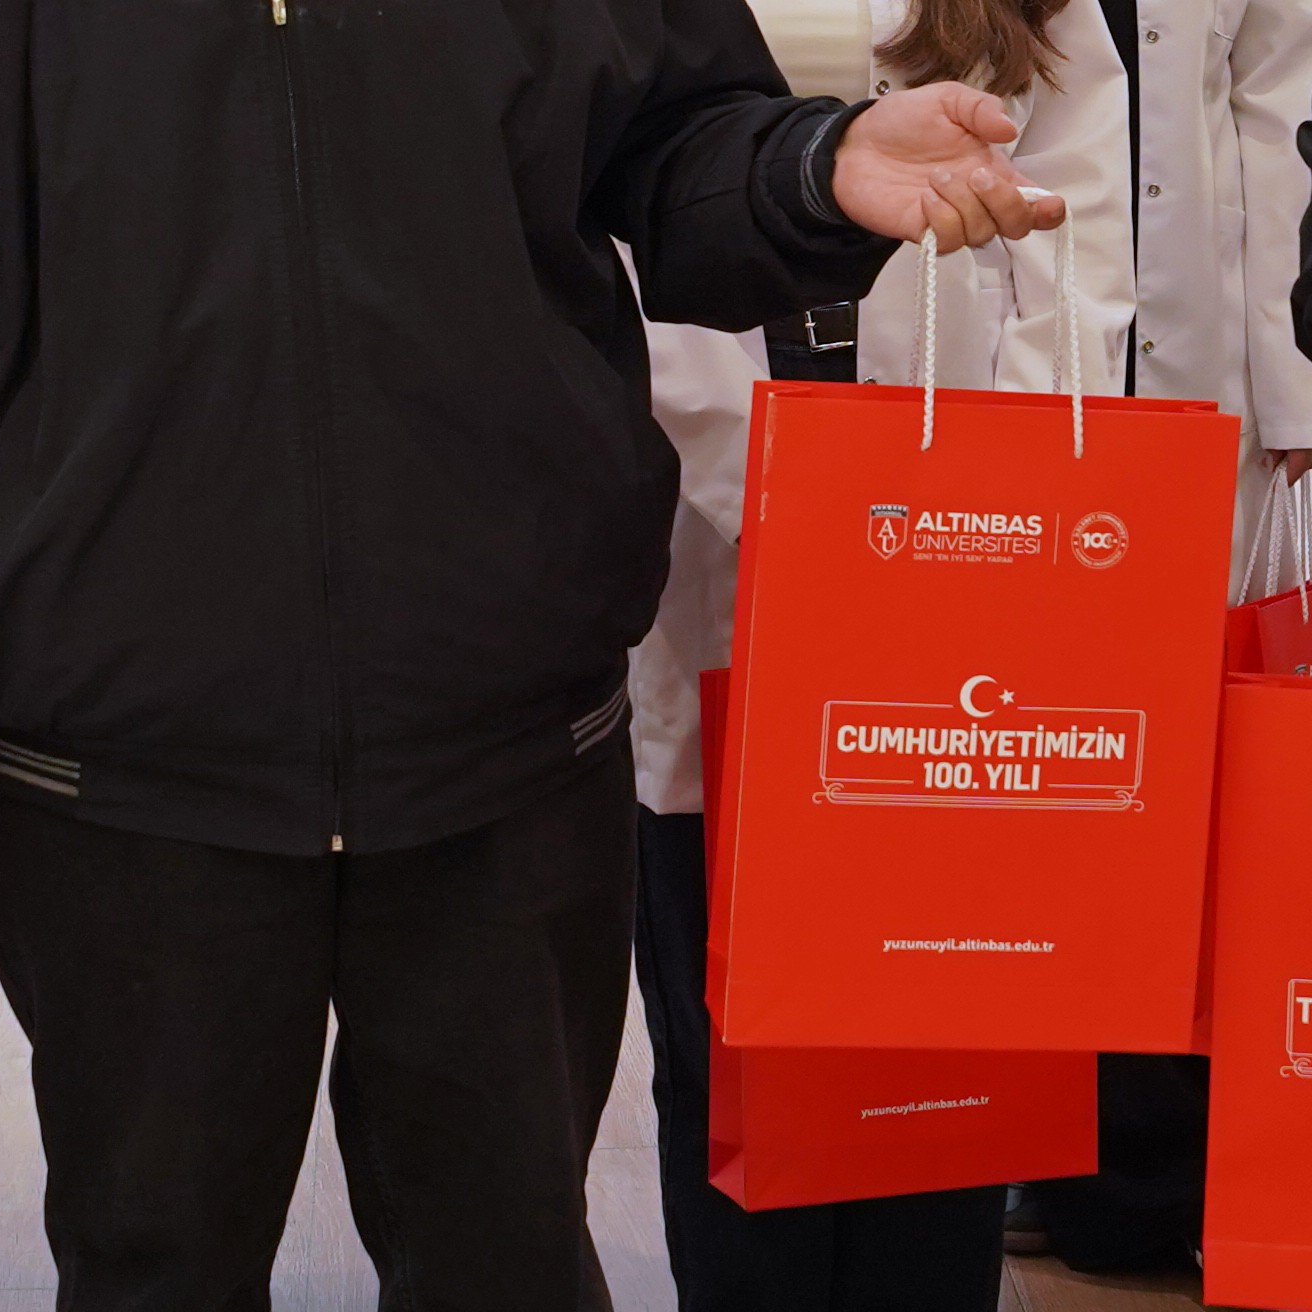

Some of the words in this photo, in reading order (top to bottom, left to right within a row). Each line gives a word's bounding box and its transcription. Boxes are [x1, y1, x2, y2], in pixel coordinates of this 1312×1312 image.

[837, 722, 1126, 760] CUMHURİYETİMİZİN
[923, 761, 980, 789] 100.
[985, 763, 1041, 791] YILI
[882, 938, 1056, 954] yuzuncuyil.altinbas.edu.tr
[860, 1095, 990, 1120] yuzuncuyil.altinbas.edu.tr
